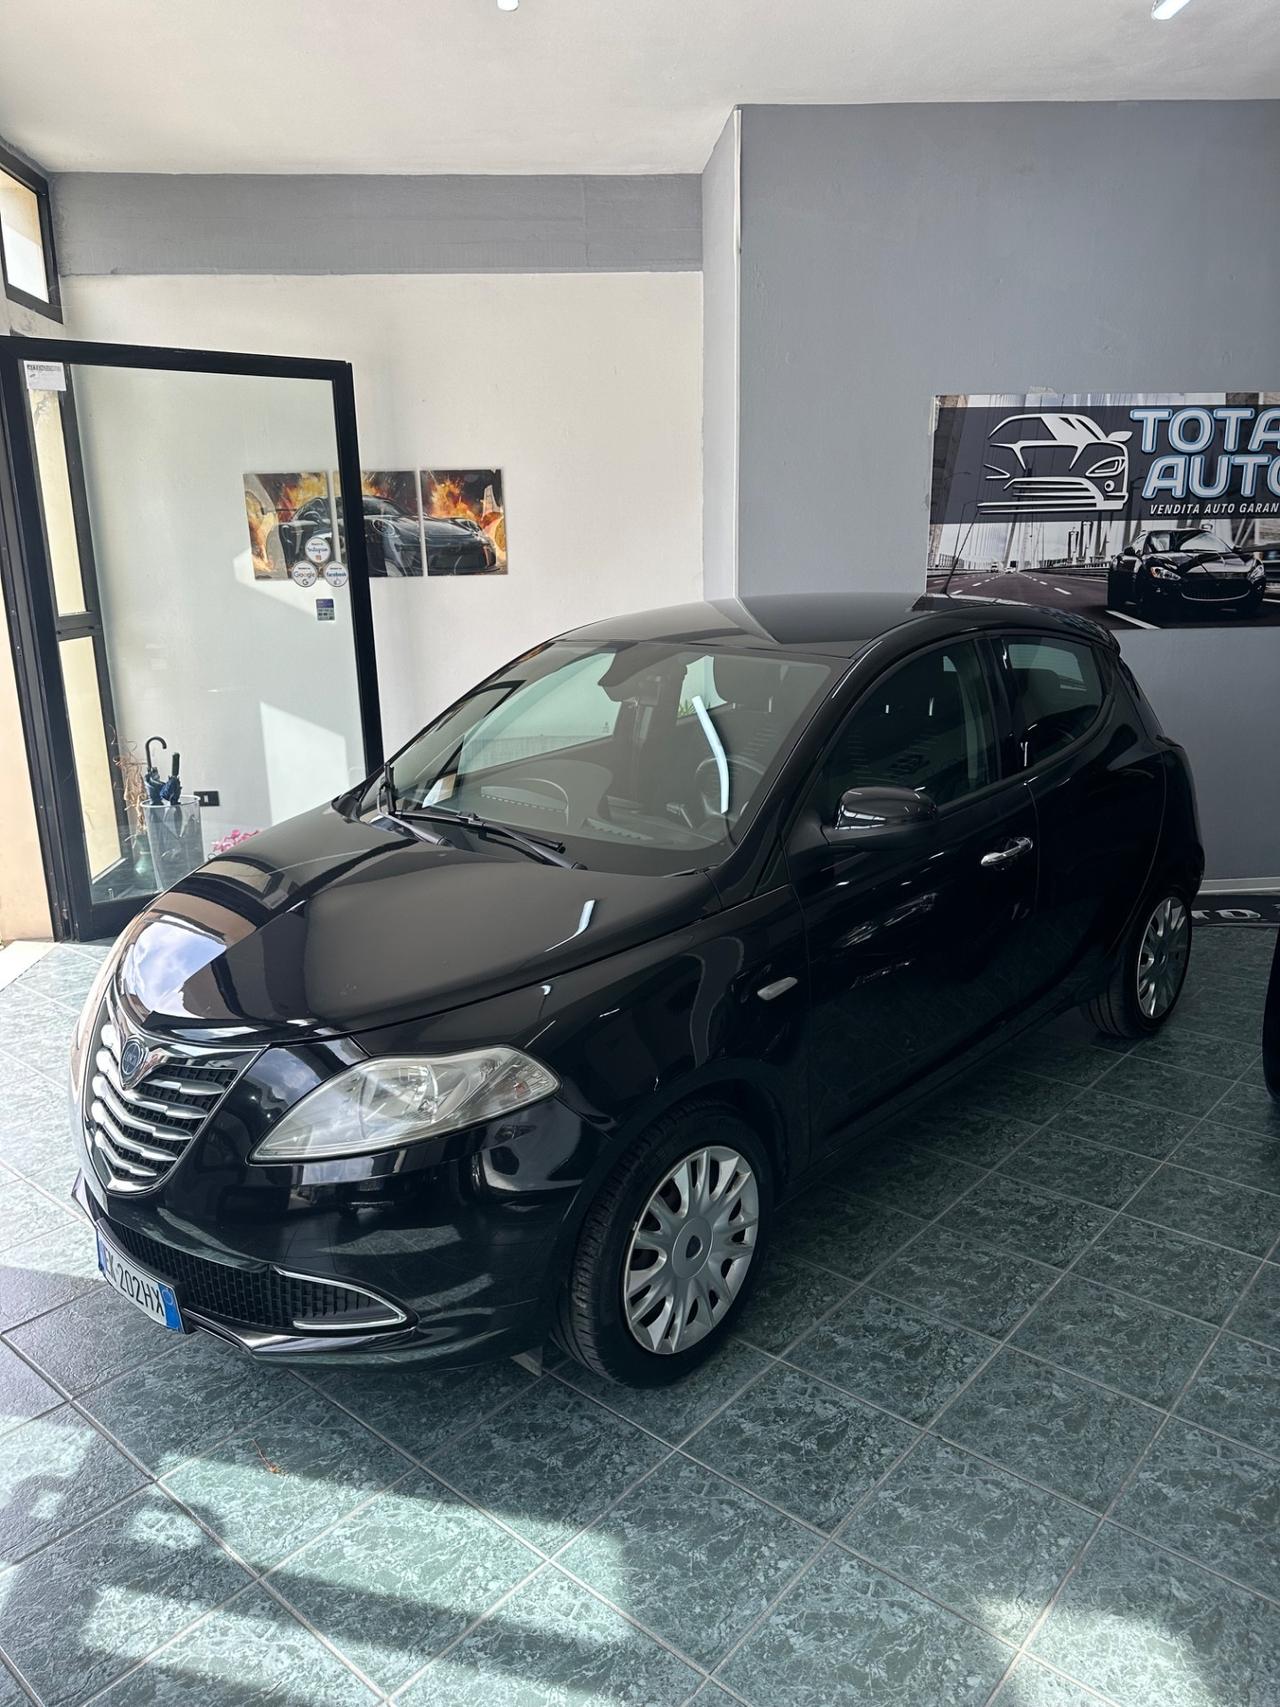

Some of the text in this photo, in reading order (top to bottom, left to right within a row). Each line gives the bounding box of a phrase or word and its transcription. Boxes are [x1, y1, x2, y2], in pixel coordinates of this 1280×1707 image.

[1142, 455, 1280, 499] AUT
[1150, 503, 1200, 515] VENDITA
[1204, 503, 1235, 514] AUTO
